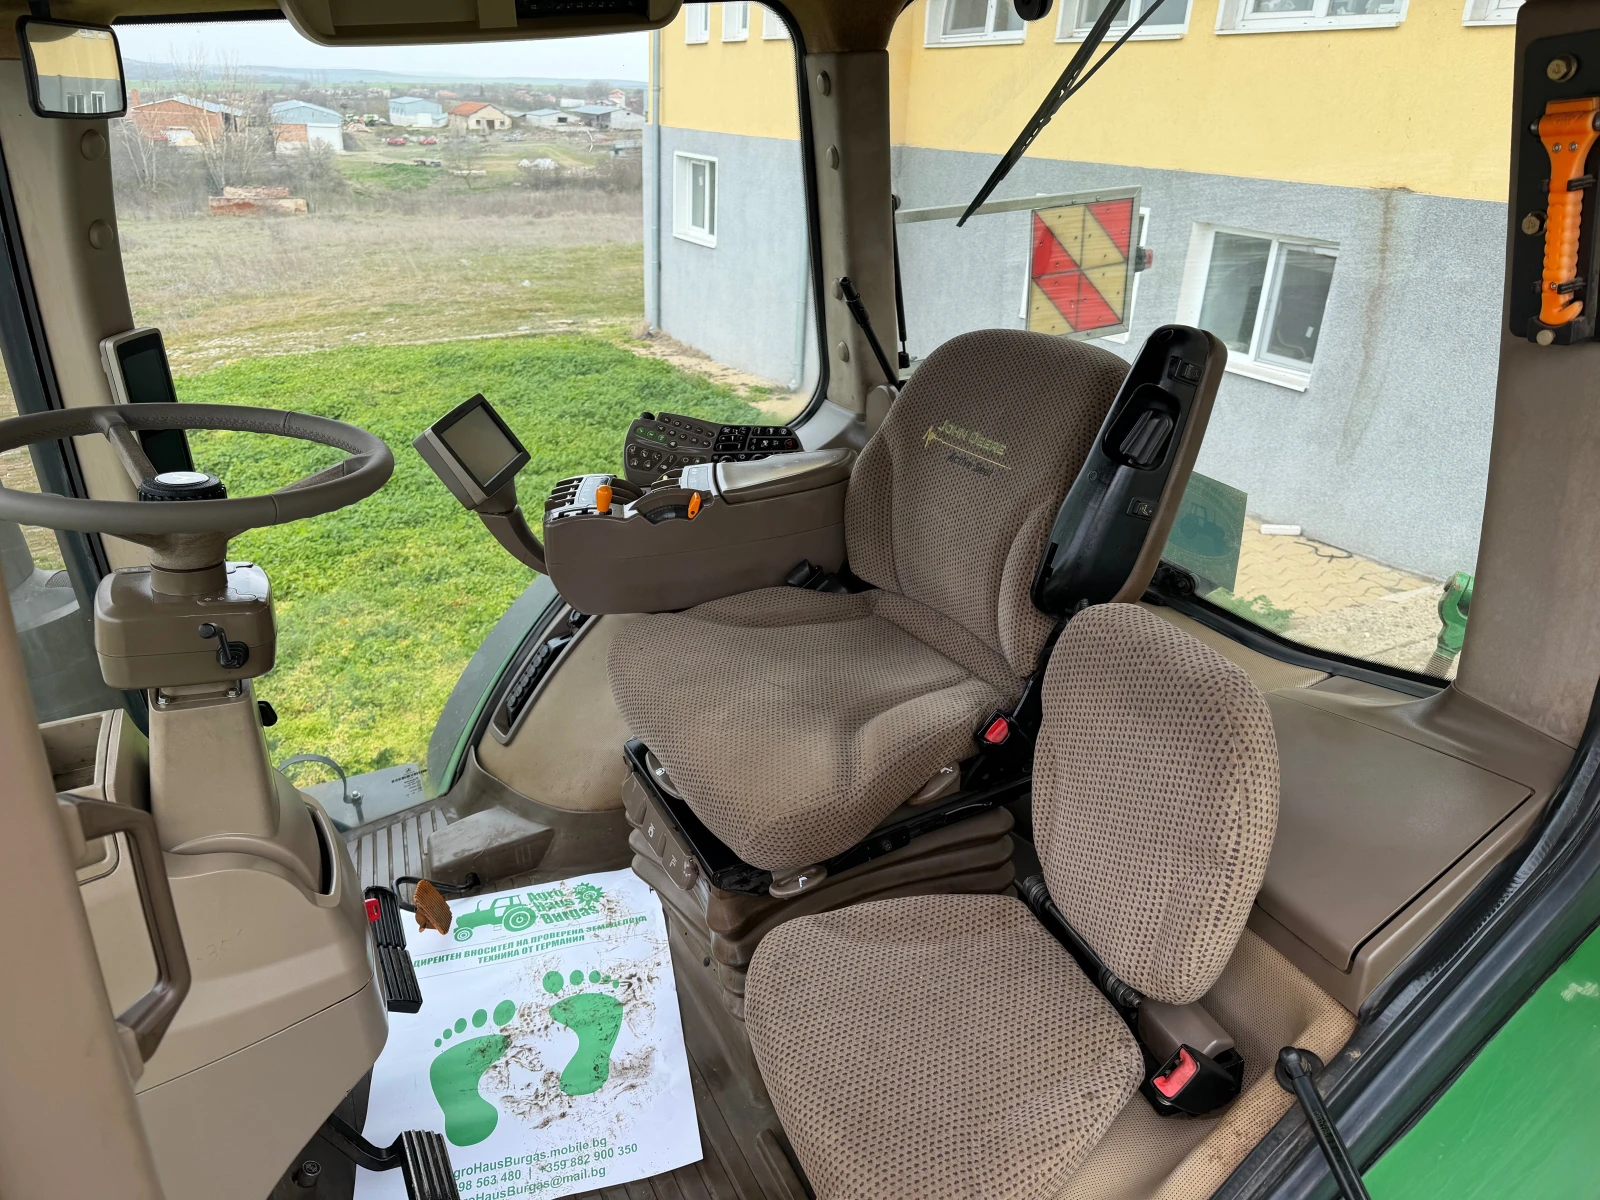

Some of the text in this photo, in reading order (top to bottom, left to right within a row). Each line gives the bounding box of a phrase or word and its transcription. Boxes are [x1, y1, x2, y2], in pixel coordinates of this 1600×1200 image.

[938, 420, 1006, 455] JOHN DEERE
[527, 890, 566, 902] Agro
[533, 898, 575, 912] Haus
[540, 905, 600, 924] Burgas
[413, 952, 462, 968] ДИРЕКТЕН
[464, 941, 514, 958] ВНОСИТЕЛ
[516, 938, 529, 947] НА
[530, 928, 584, 943] ПРОВЕРЕНА
[478, 935, 585, 964] ТЕХНИКА ОТ ГЕРМАНИЯ
[453, 1137, 607, 1180] groHausBurgas.mobile.bg
[458, 1180, 472, 1192] 98
[476, 1174, 497, 1188] 563
[500, 1169, 521, 1182] 480
[570, 1154, 590, 1167] 882
[594, 1147, 614, 1160] 900
[617, 1143, 638, 1156] 350
